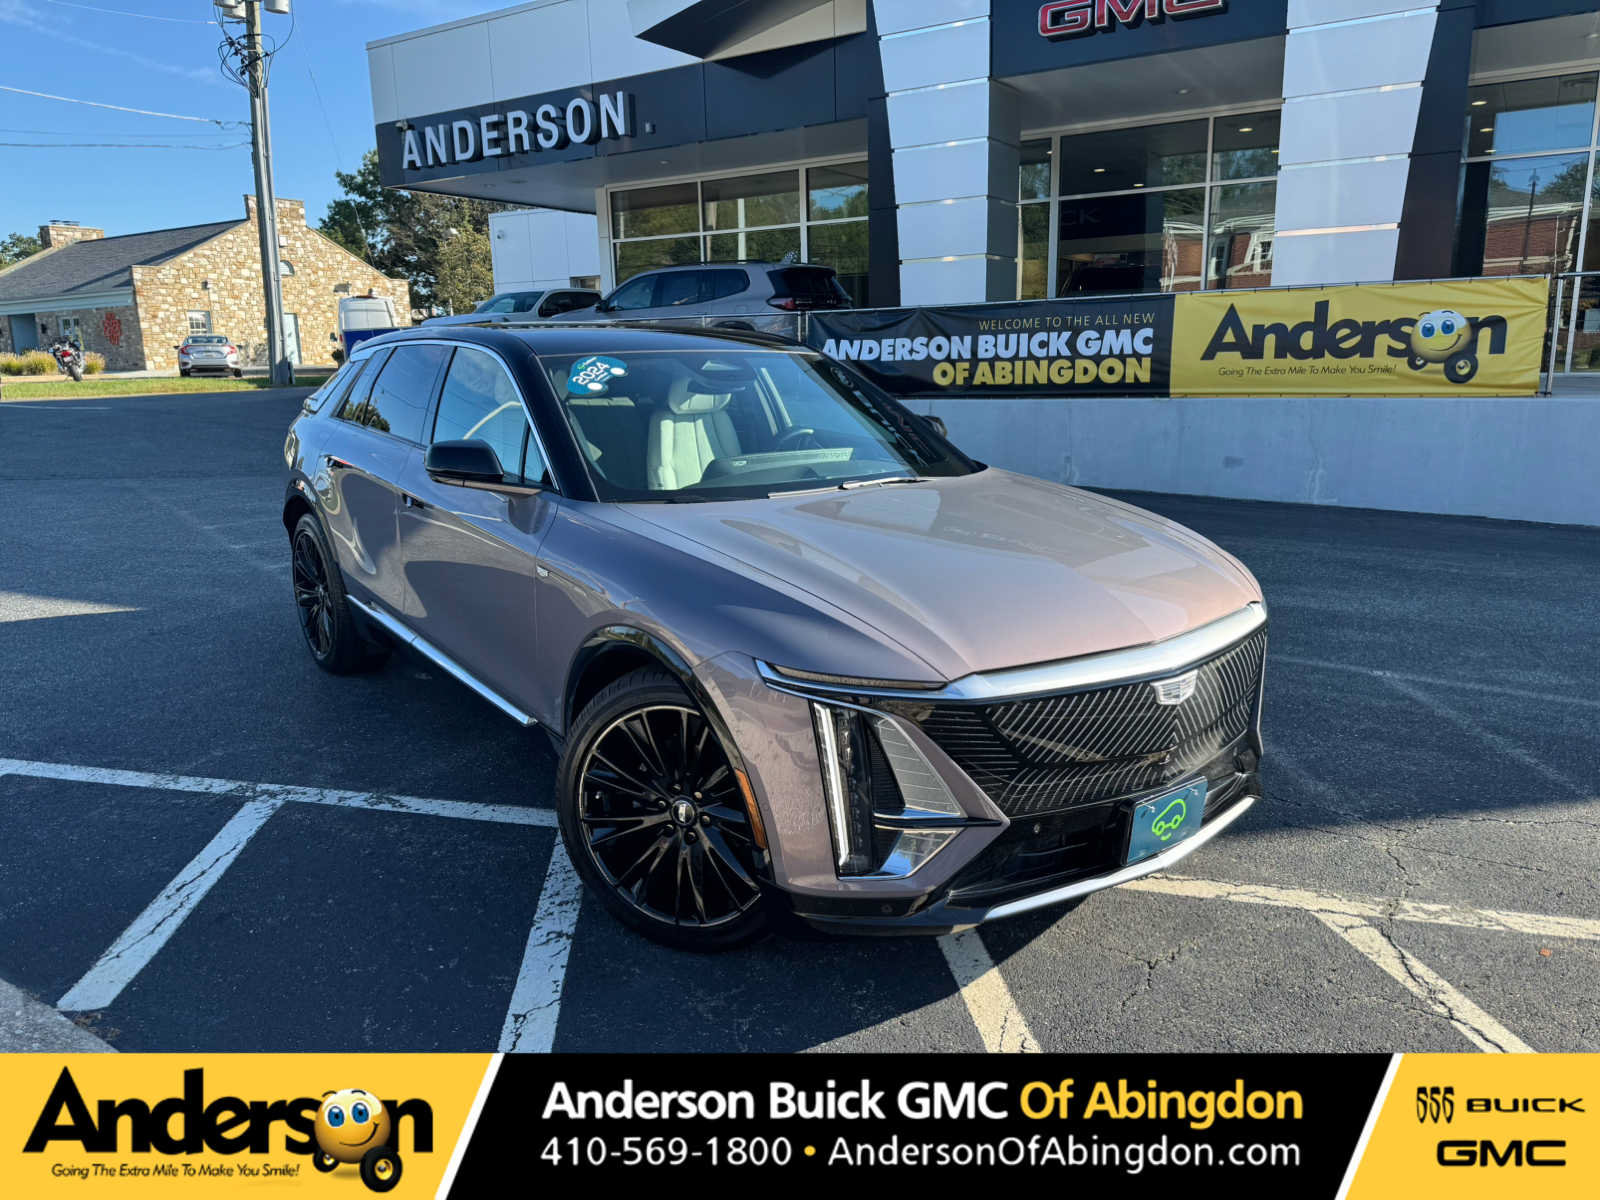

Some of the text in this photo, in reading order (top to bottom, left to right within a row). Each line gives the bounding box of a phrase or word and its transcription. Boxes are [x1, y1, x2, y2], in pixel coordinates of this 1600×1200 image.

[402, 91, 625, 169] ANDERSON
[979, 312, 1156, 331] WELCOME TO THE ALL NEW
[822, 328, 1154, 361] ANDERSON BUICK GMC
[572, 362, 610, 386] 2024
[932, 357, 1152, 387] OF ABINGDON
[1218, 364, 1397, 378] Going The Extra Mile To Make You Smile!
